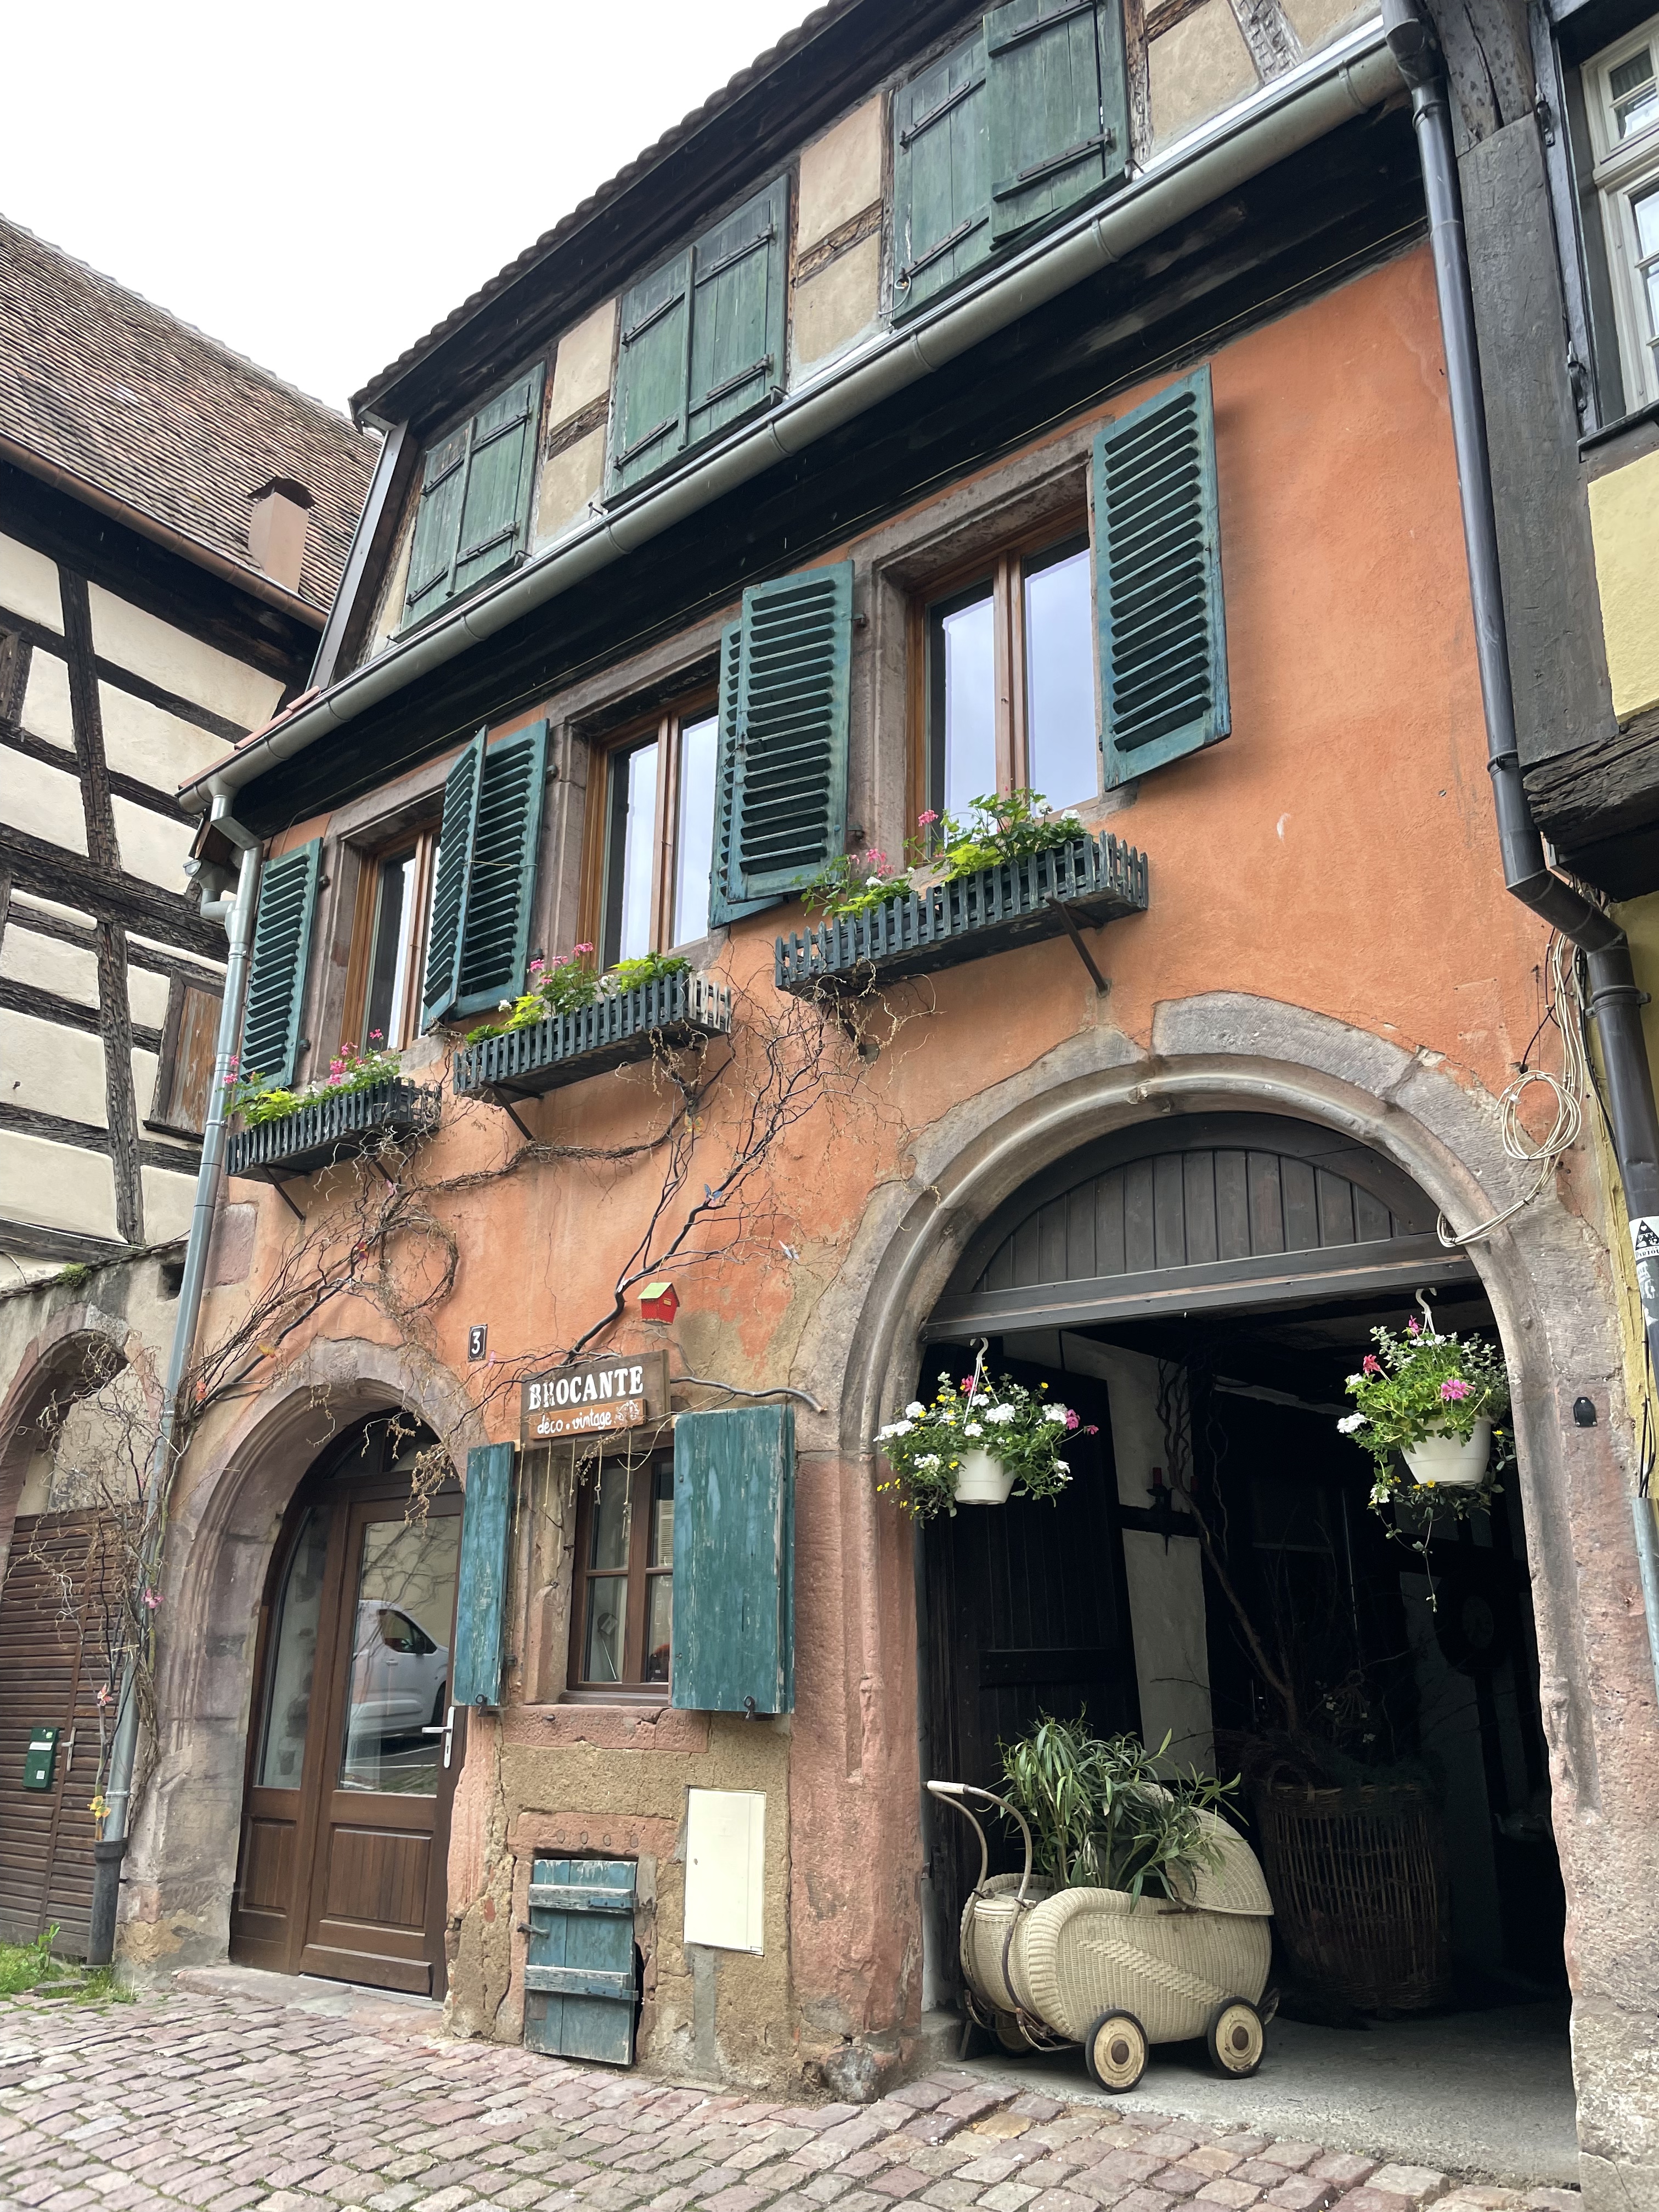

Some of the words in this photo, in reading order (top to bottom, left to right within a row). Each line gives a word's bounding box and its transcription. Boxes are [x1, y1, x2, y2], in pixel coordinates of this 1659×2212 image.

[471, 1331, 481, 1355] 3
[528, 1365, 644, 1410] BROCANTE
[572, 1408, 612, 1430] vintage
